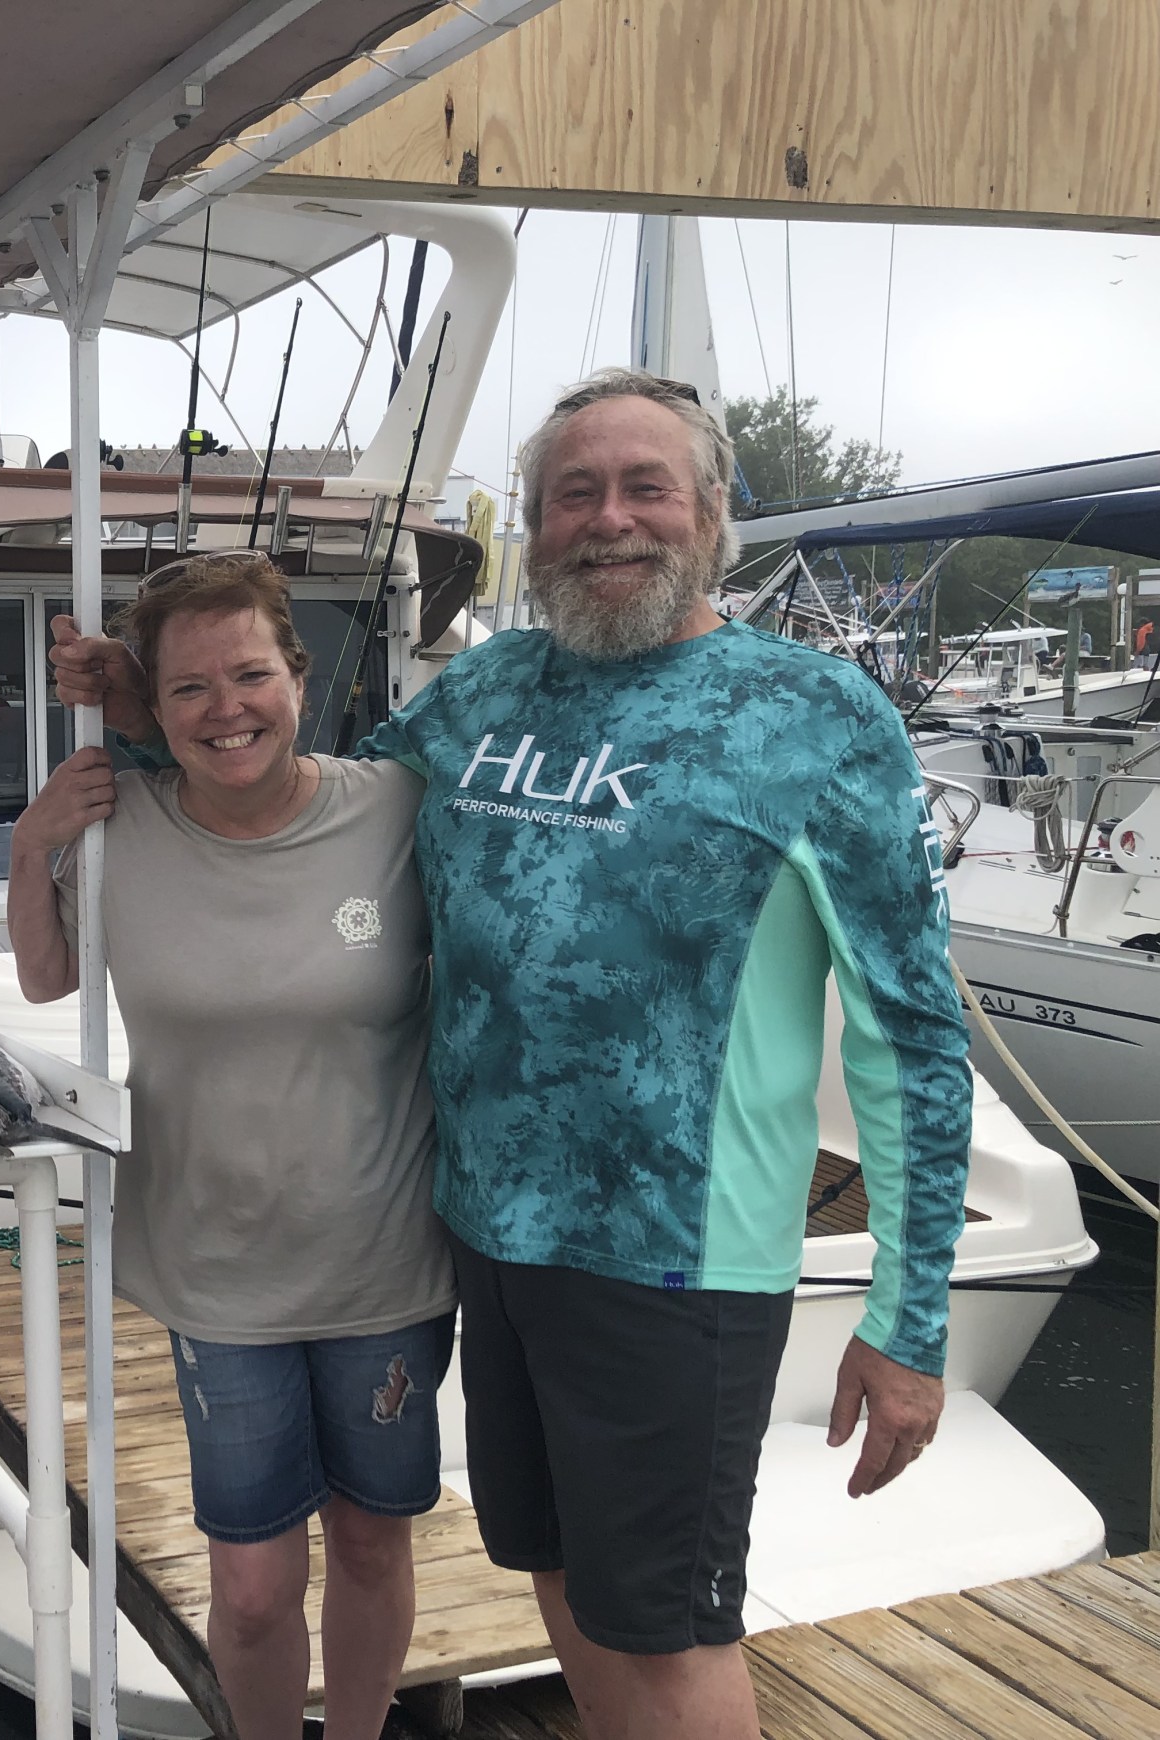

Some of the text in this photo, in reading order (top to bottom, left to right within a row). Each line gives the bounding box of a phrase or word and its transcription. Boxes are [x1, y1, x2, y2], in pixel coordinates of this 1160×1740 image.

[452, 798, 627, 834] PERFORMANCE FISHING
[1035, 1004, 1076, 1026] 373
